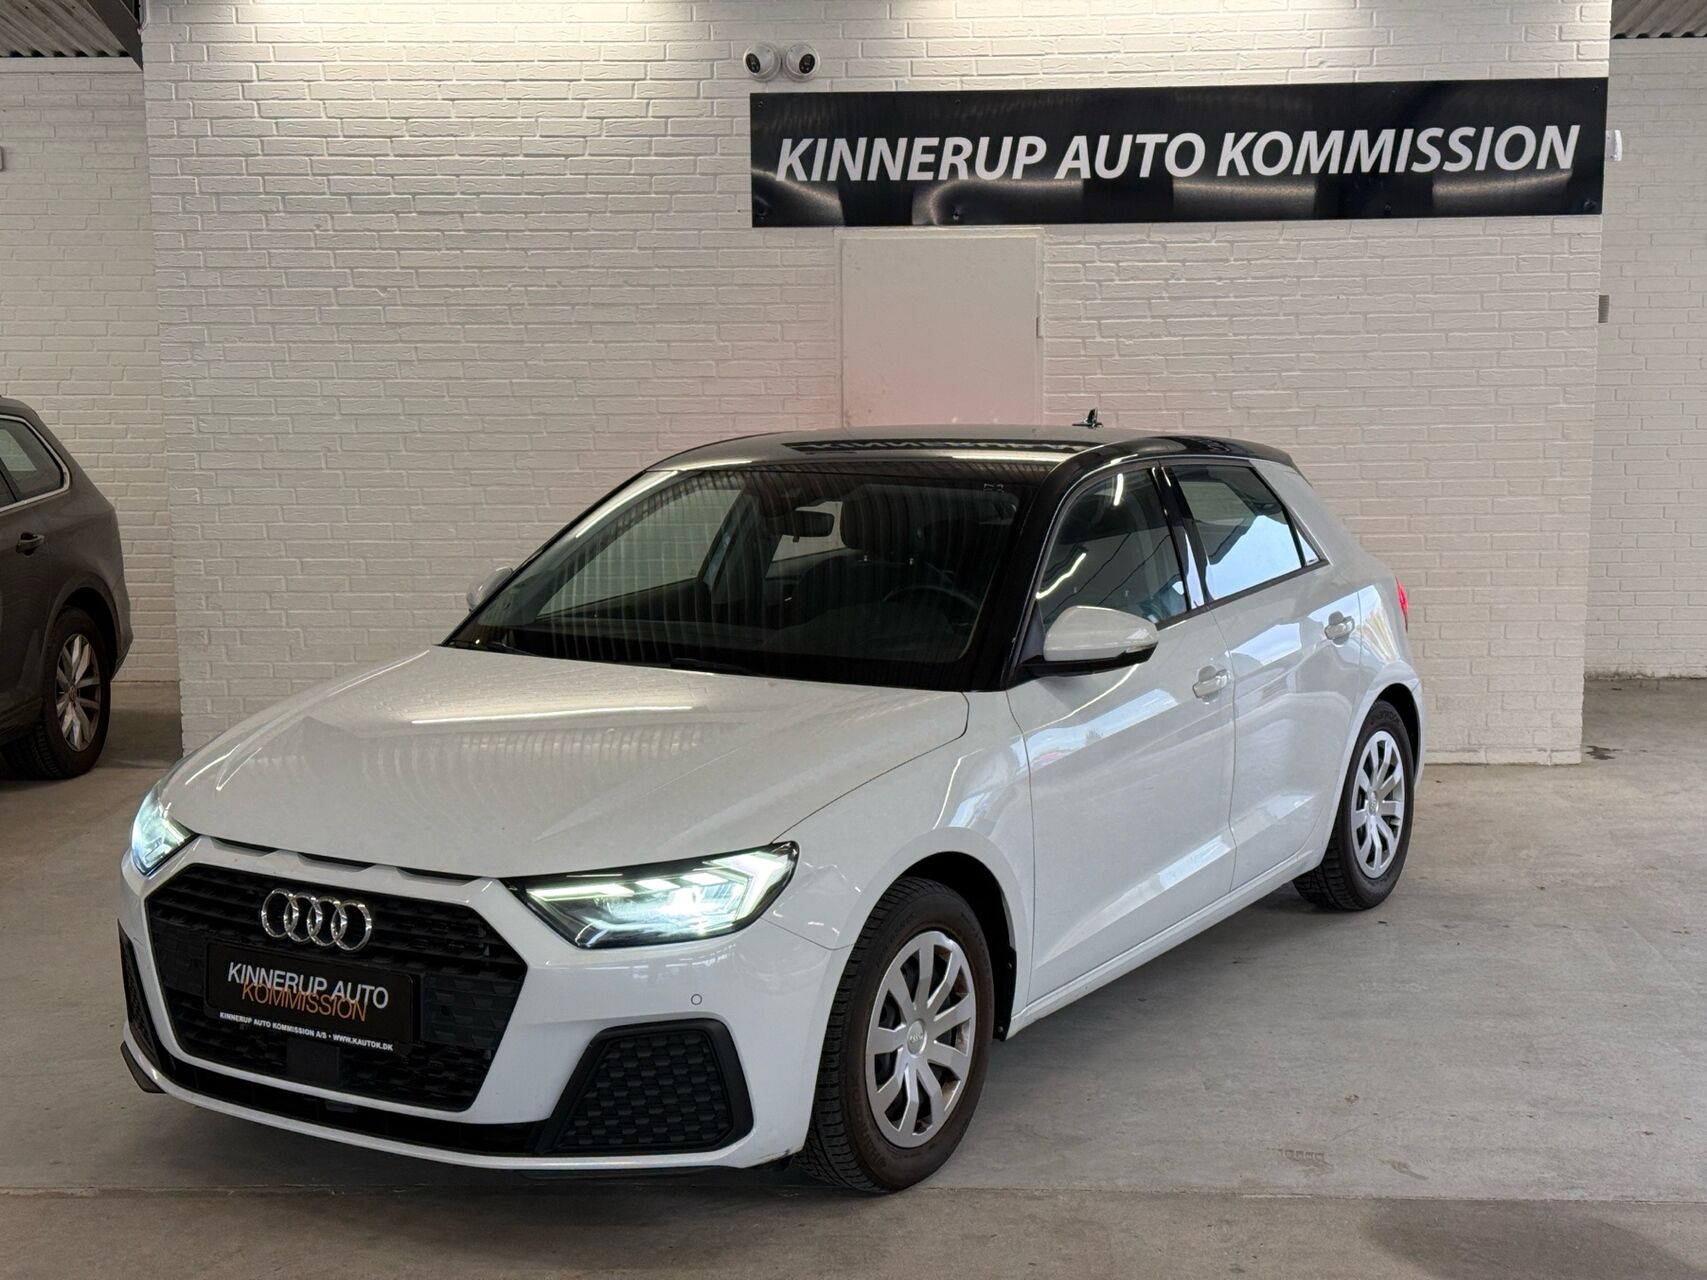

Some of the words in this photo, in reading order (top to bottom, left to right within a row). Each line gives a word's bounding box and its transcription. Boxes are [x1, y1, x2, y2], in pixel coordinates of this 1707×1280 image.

[776, 135, 1047, 182] KINNERUP
[1055, 132, 1206, 179] AUTO
[1217, 124, 1581, 177] KOMMISSION
[228, 962, 328, 997] KINNERUP
[331, 980, 389, 1009] AUTO
[241, 982, 368, 1021] KOMMISSION
[219, 1011, 252, 1024] KINNERUP
[253, 1018, 271, 1029] AUTO
[272, 1022, 315, 1037] KOMMISSION
[315, 1031, 327, 1040] A/S
[333, 1033, 394, 1051] WWW.KAUTOK.DK
